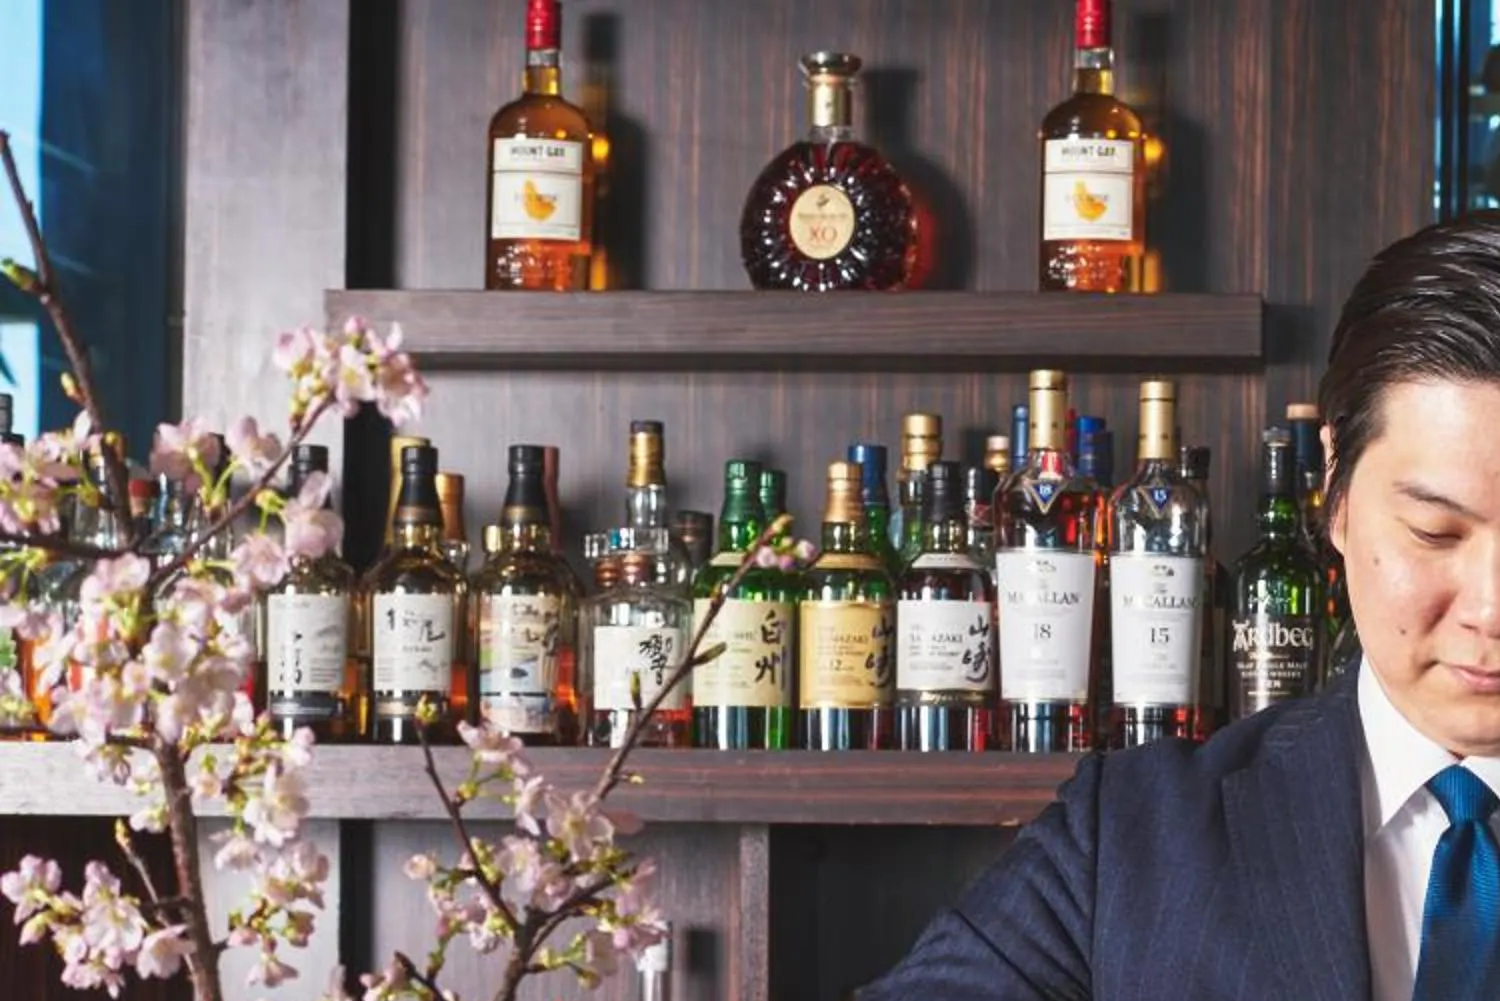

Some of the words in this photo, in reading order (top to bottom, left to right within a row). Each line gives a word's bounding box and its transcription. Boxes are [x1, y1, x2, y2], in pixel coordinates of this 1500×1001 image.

[810, 226, 838, 243] XO
[1153, 489, 1167, 502] 15
[1007, 591, 1081, 605] MAALLAN
[1034, 623, 1052, 640] 18
[1150, 627, 1169, 644] 15
[755, 609, 787, 692] 白州
